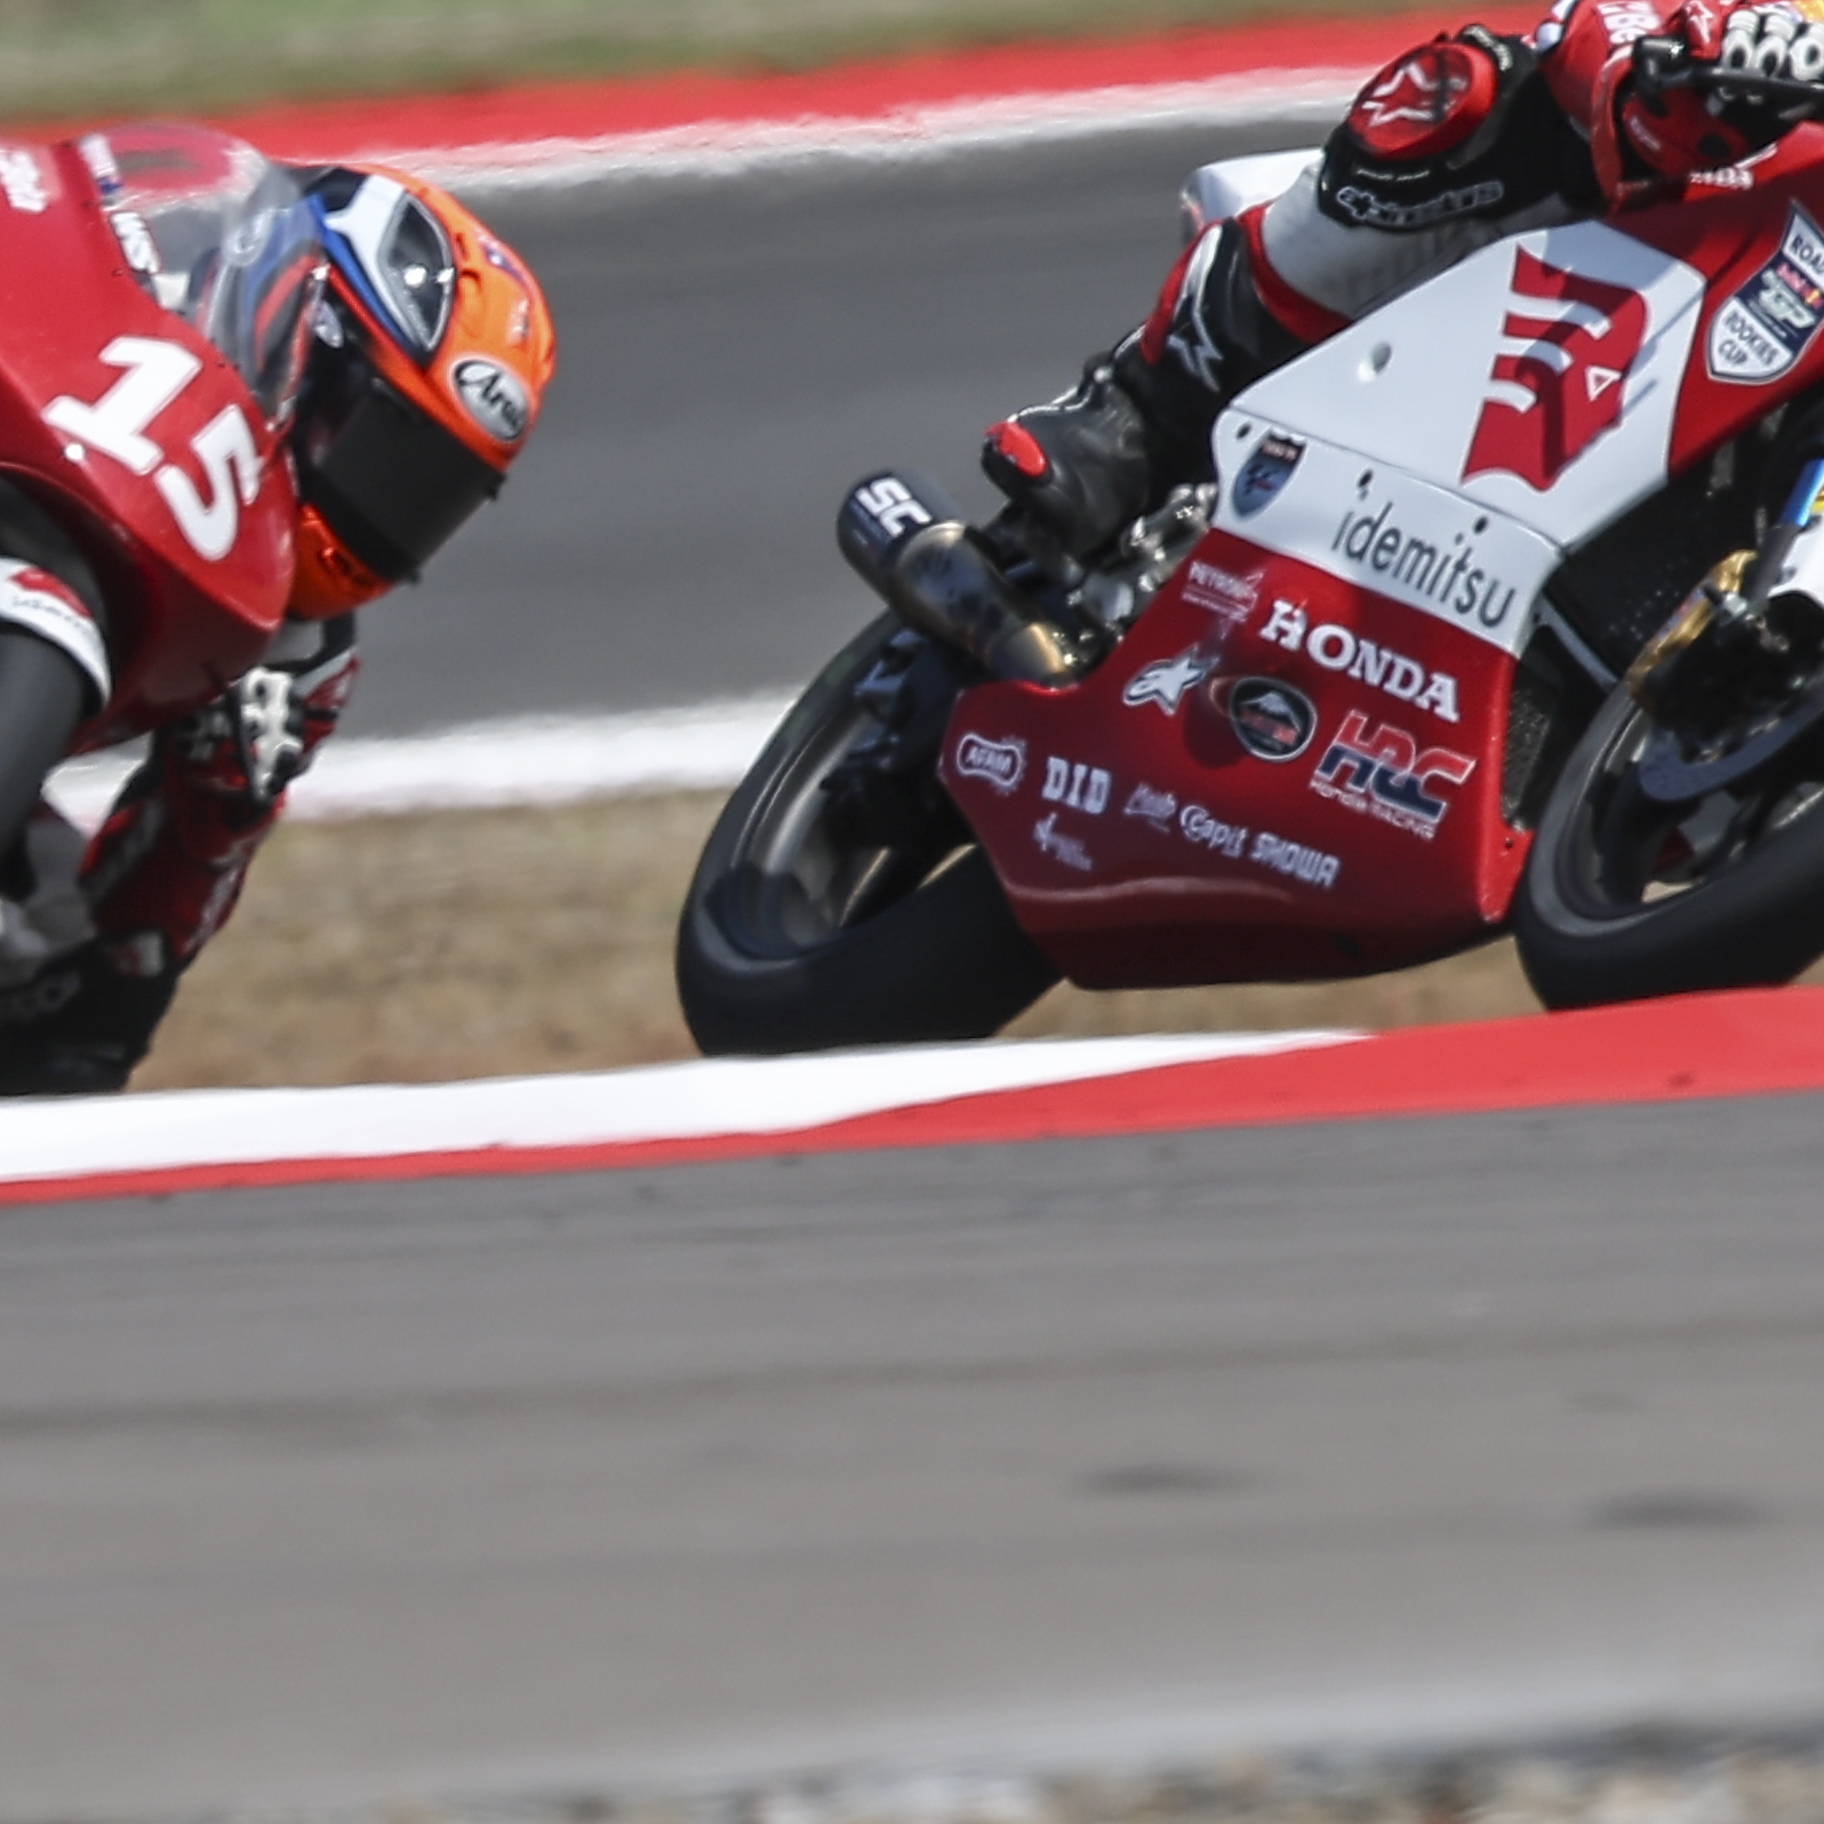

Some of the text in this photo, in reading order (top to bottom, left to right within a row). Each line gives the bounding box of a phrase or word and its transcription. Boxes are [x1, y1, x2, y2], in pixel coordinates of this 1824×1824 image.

[1717, 339, 1748, 367] CUP
[1723, 310, 1781, 366] ROOKIES
[42, 334, 262, 562] 15
[854, 476, 933, 538] SC
[1331, 490, 1517, 630] idemitsu
[1259, 599, 1461, 723] HONDA
[1041, 755, 1112, 816] DID
[1318, 709, 1478, 824] HRC
[1251, 832, 1342, 889] SHOWA
